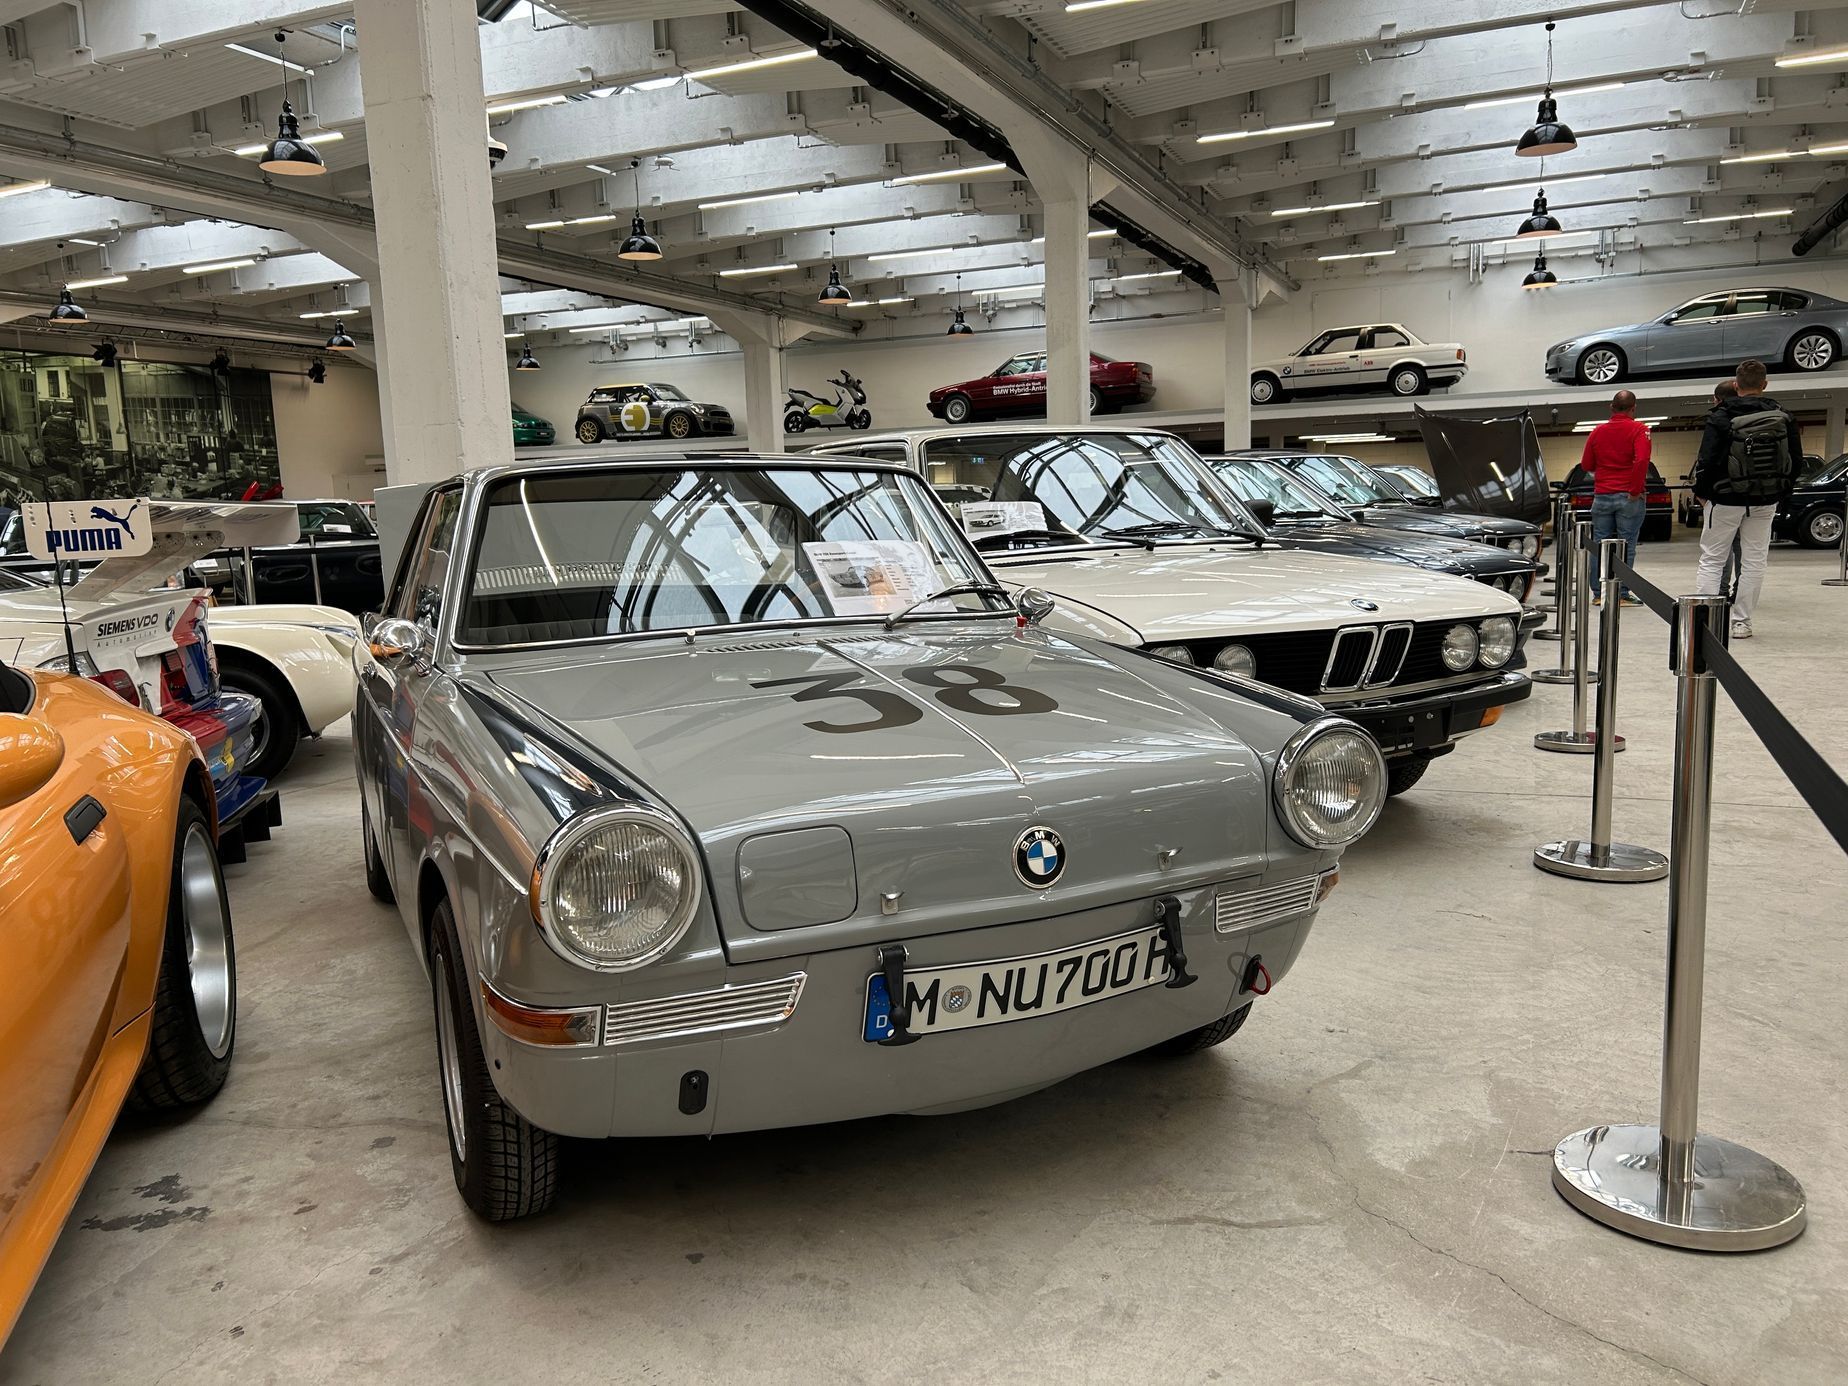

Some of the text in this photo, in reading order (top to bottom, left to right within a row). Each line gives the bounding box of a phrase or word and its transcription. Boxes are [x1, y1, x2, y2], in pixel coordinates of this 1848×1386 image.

[993, 388, 1009, 396] BMW
[46, 527, 122, 553] PUMA
[97, 613, 159, 637] SIEMENS VDO
[750, 665, 1059, 734] 38
[1020, 830, 1060, 852] BMW
[876, 1014, 888, 1029] D
[905, 978, 940, 1029] M
